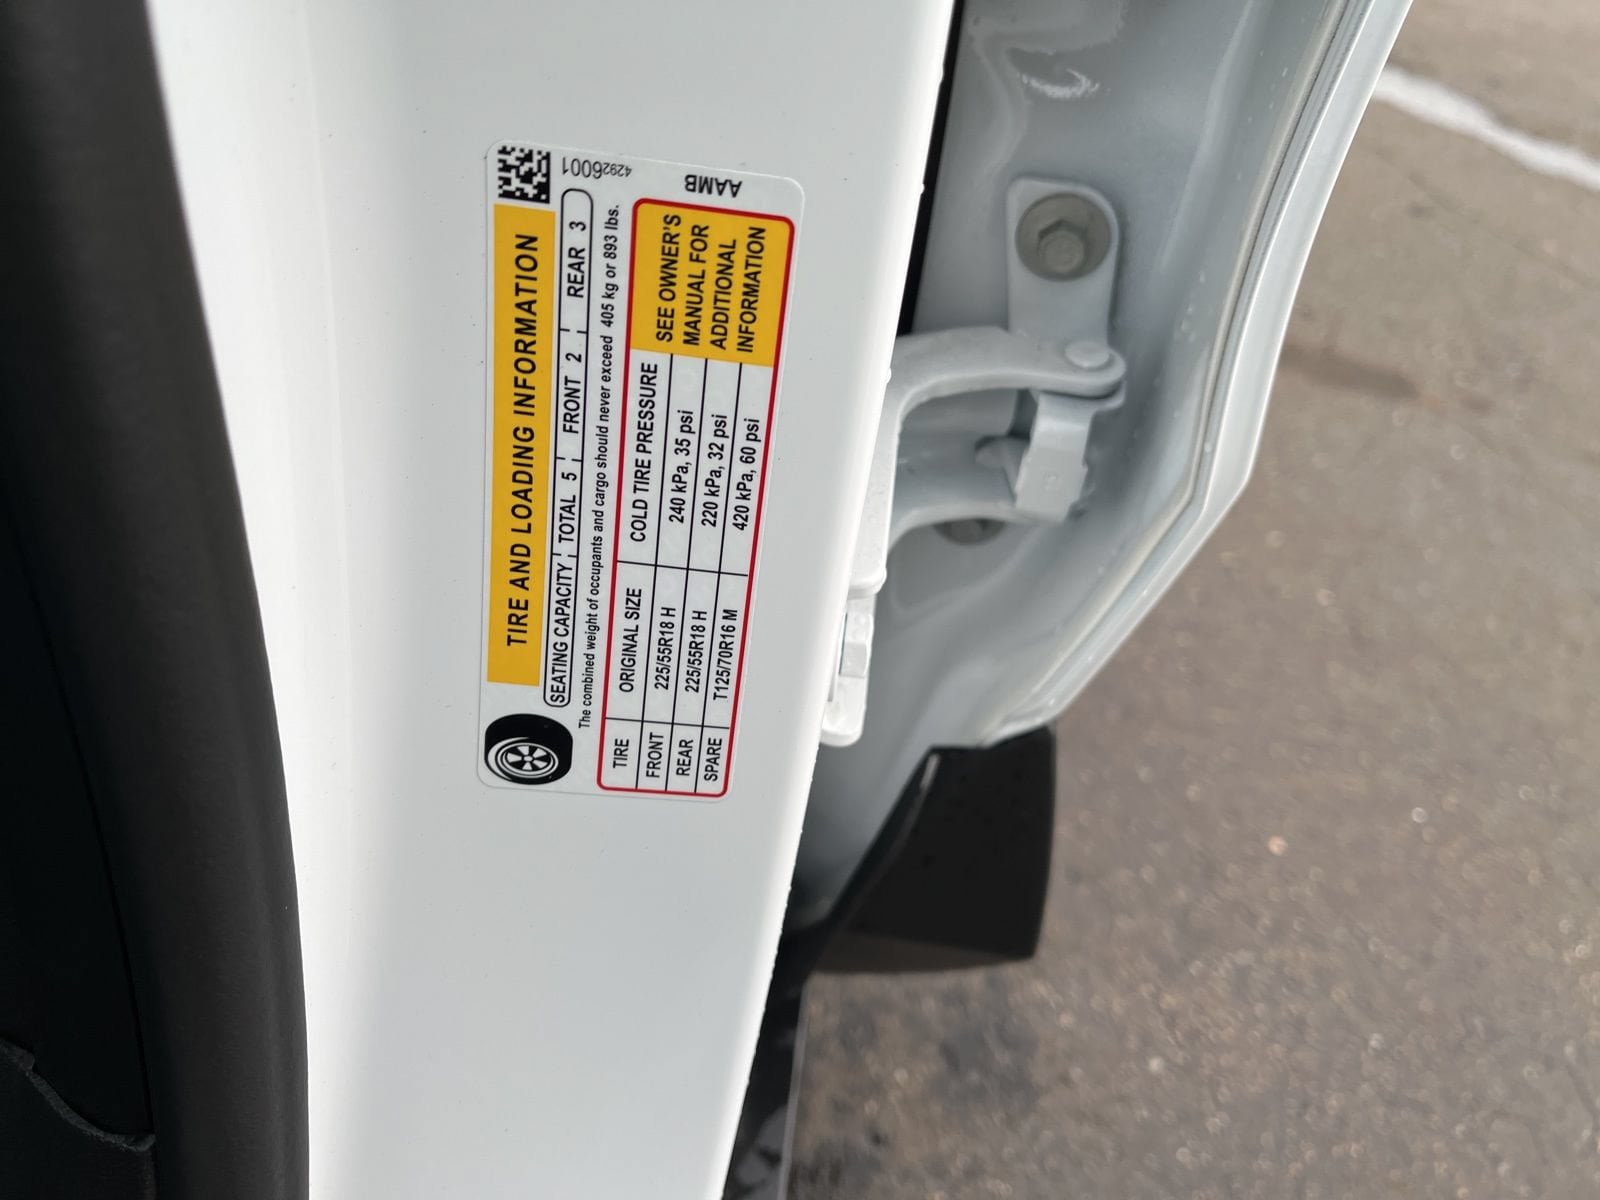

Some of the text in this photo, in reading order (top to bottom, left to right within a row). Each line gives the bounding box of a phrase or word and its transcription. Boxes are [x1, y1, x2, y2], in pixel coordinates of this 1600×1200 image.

[562, 156, 632, 179] 42926001
[684, 174, 742, 198] AAMB
[656, 213, 682, 343] SEE OWNER'S
[683, 224, 710, 346] MANUAL FOR
[709, 239, 736, 350] ADDITIONAL
[736, 227, 766, 353] INFORMATION
[507, 234, 539, 646] TIRE AND LOADING INFORMATION
[550, 221, 586, 703] SEATING CAPACITY TOTAL 5 FRONT 2 REAR 3
[578, 205, 619, 728] The combined weight of occupants and cargo should never exceed 405 kg or 893 lbs.
[630, 362, 657, 542] COLD TIRE PRESSURE
[669, 410, 695, 523] 240 kPa, 35 psi
[701, 414, 729, 527] 220 kPa, 32 psi
[733, 418, 761, 531] 420 kPa, 60 psi
[619, 588, 642, 692] ORIGINAL SIZE
[654, 607, 676, 690] 225/55R18 H
[685, 610, 707, 693] 225/55R18 H
[713, 609, 738, 700] T125/70R16 M
[613, 738, 629, 768] TIRE
[646, 732, 664, 778] FRONT
[676, 739, 694, 776] REAR
[704, 738, 722, 782] SPARE
